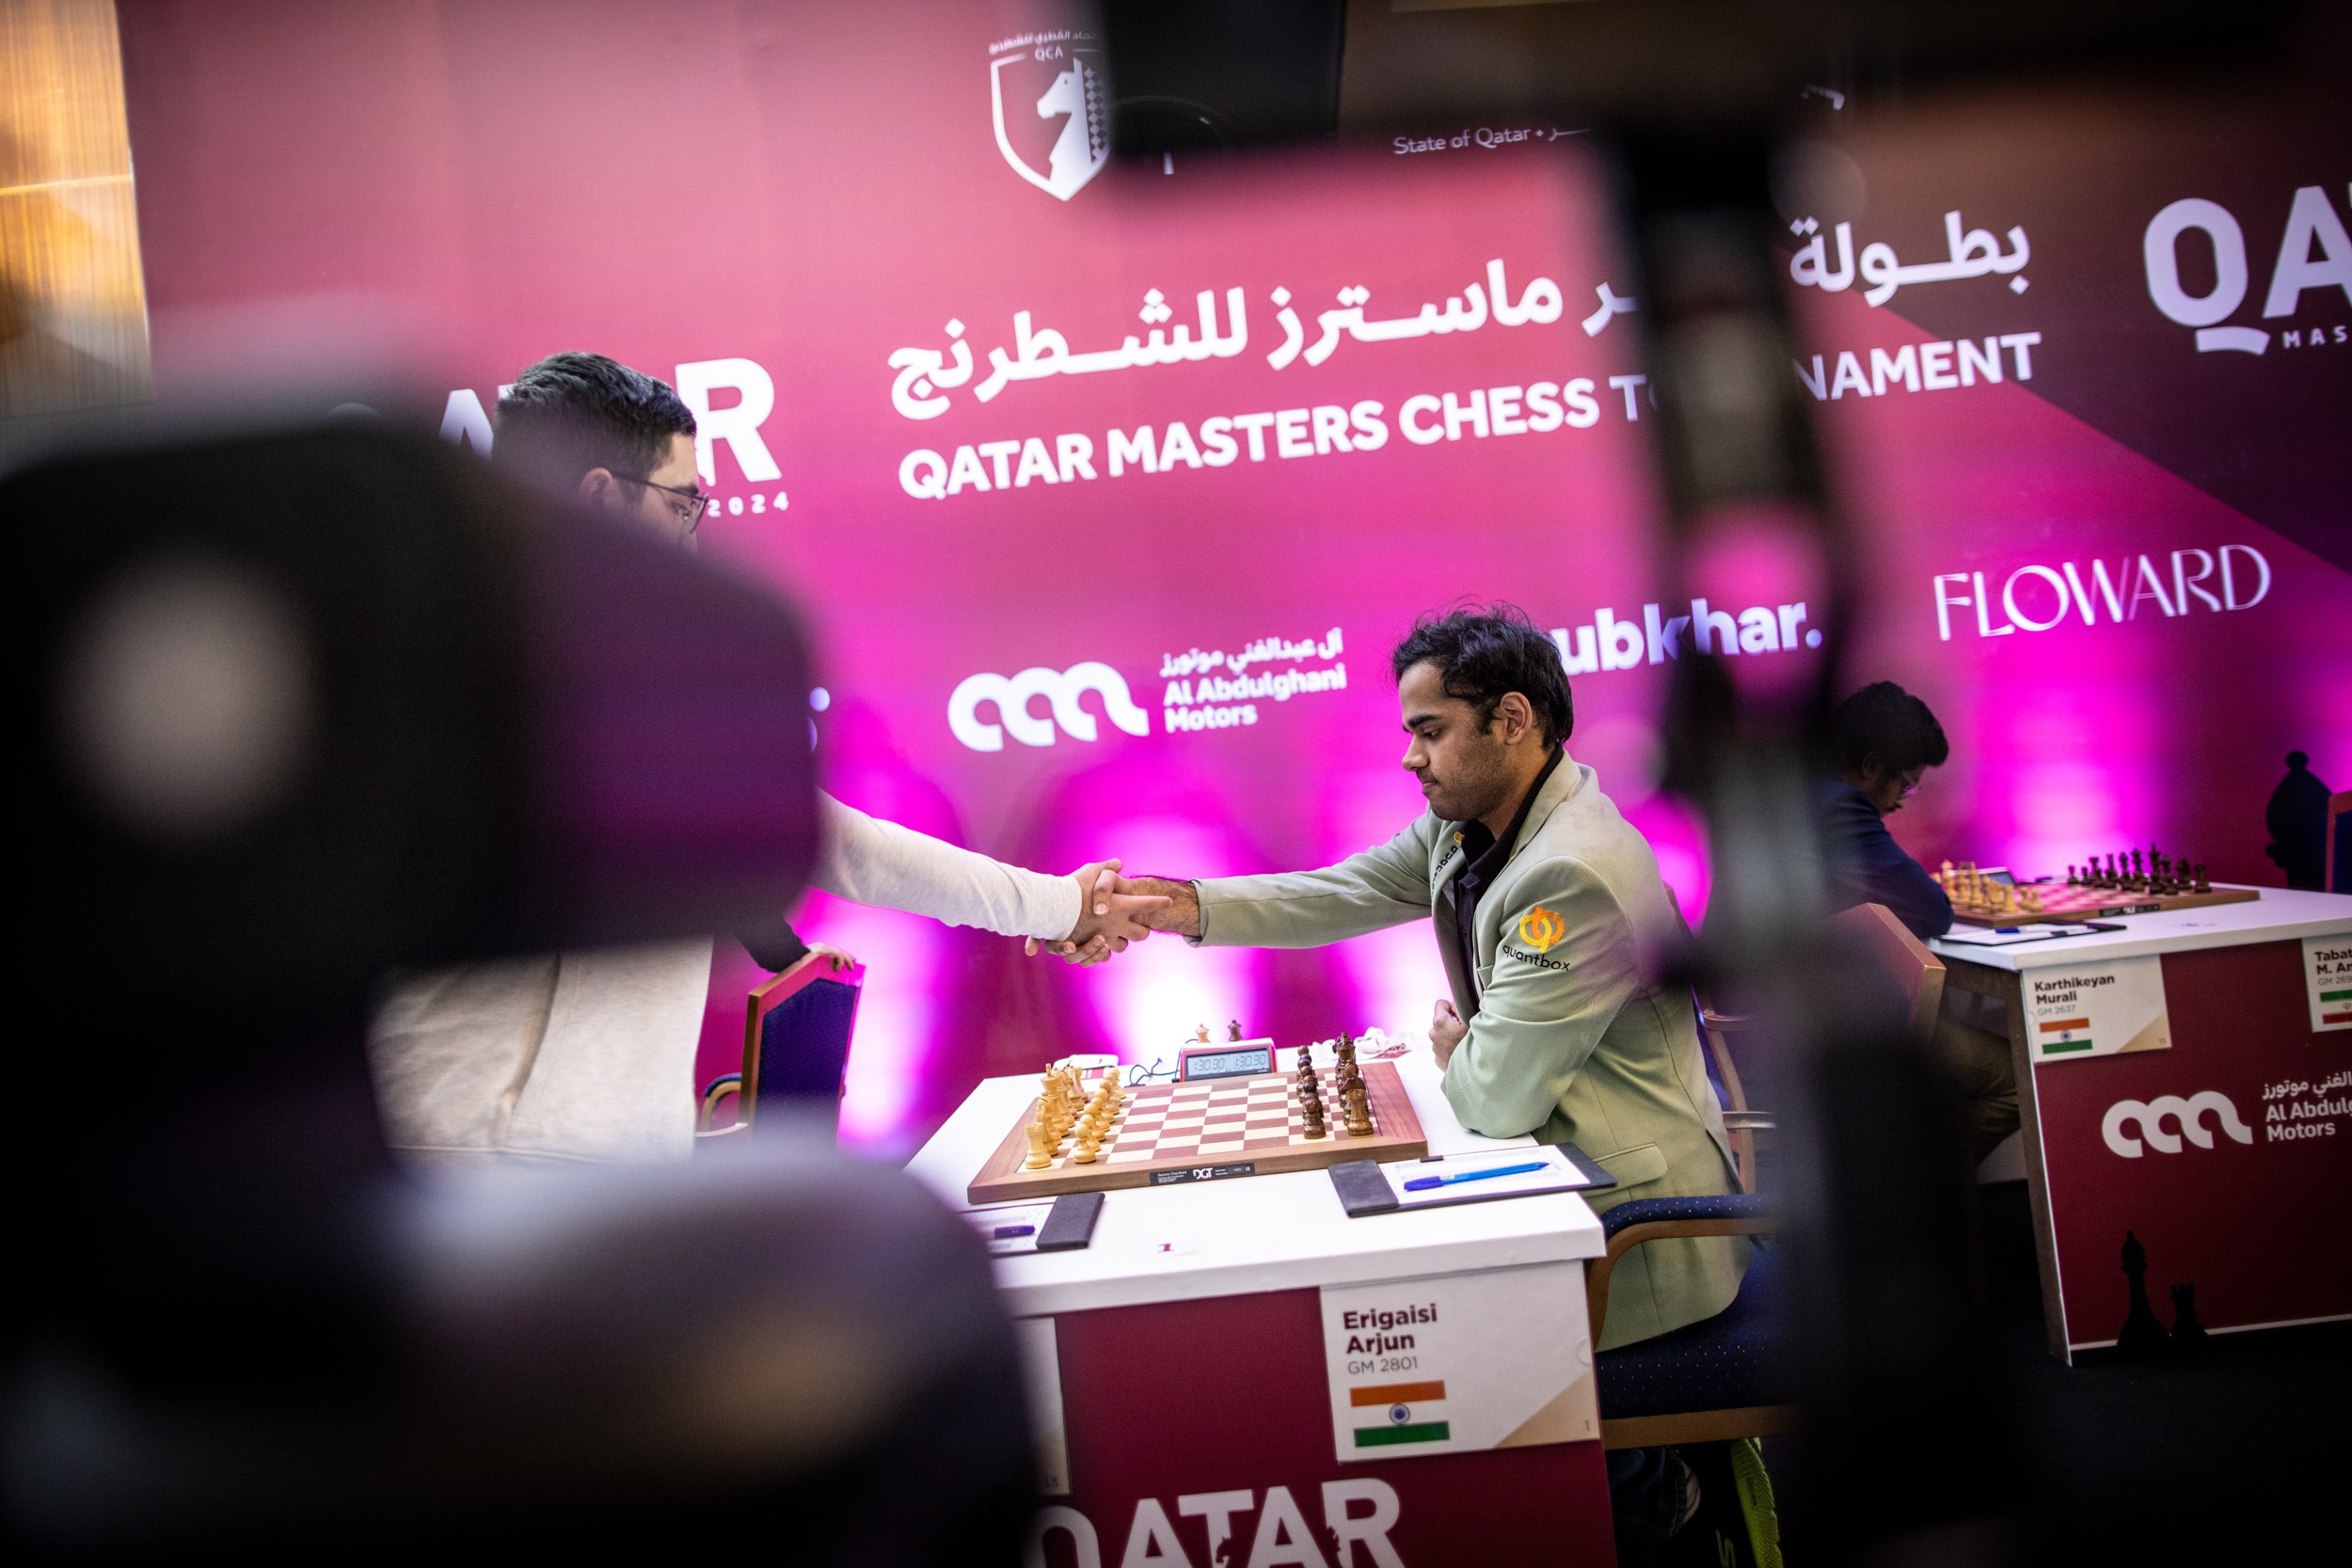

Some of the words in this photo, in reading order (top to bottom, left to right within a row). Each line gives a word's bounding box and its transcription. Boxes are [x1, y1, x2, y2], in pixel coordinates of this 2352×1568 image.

[1035, 44, 1063, 62] QCA
[1393, 135, 1446, 154] State
[1452, 132, 1470, 149] of
[1475, 126, 1531, 149] Qatar
[1789, 211, 2031, 308] بطولة
[2143, 182, 2352, 356] QA
[1267, 258, 1563, 371] ماسترز
[887, 286, 1248, 420] للشطرنج
[898, 433, 1098, 499] QATAR
[1107, 400, 1389, 478] MASTERS
[1399, 378, 1600, 445] CHESS
[1609, 331, 2041, 423] TNAMENT
[707, 490, 789, 518] 2024
[1933, 544, 2272, 641] FLOWARD
[1550, 597, 1822, 676] ubkhar.
[1163, 679, 1196, 707] Al
[1196, 662, 1347, 702] Abdulghani
[1164, 704, 1258, 733] Motors
[1502, 943, 1571, 972] quantbox
[2316, 964, 2332, 975] M.
[2034, 974, 2115, 992] Karthikeyan
[2318, 977, 2333, 987] GM
[2036, 990, 2077, 1005] Murali
[2038, 1007, 2053, 1017] GM
[2263, 1080, 2309, 1100] موتورز
[2265, 1103, 2287, 1122] Al
[2266, 1122, 2336, 1142] Motors
[1193, 1167, 1213, 1180] DGT
[1343, 1303, 1438, 1331] Erigaisi
[1346, 1332, 1415, 1355] Arjun
[1347, 1360, 1375, 1374] GM
[1380, 1355, 1418, 1371] 2801
